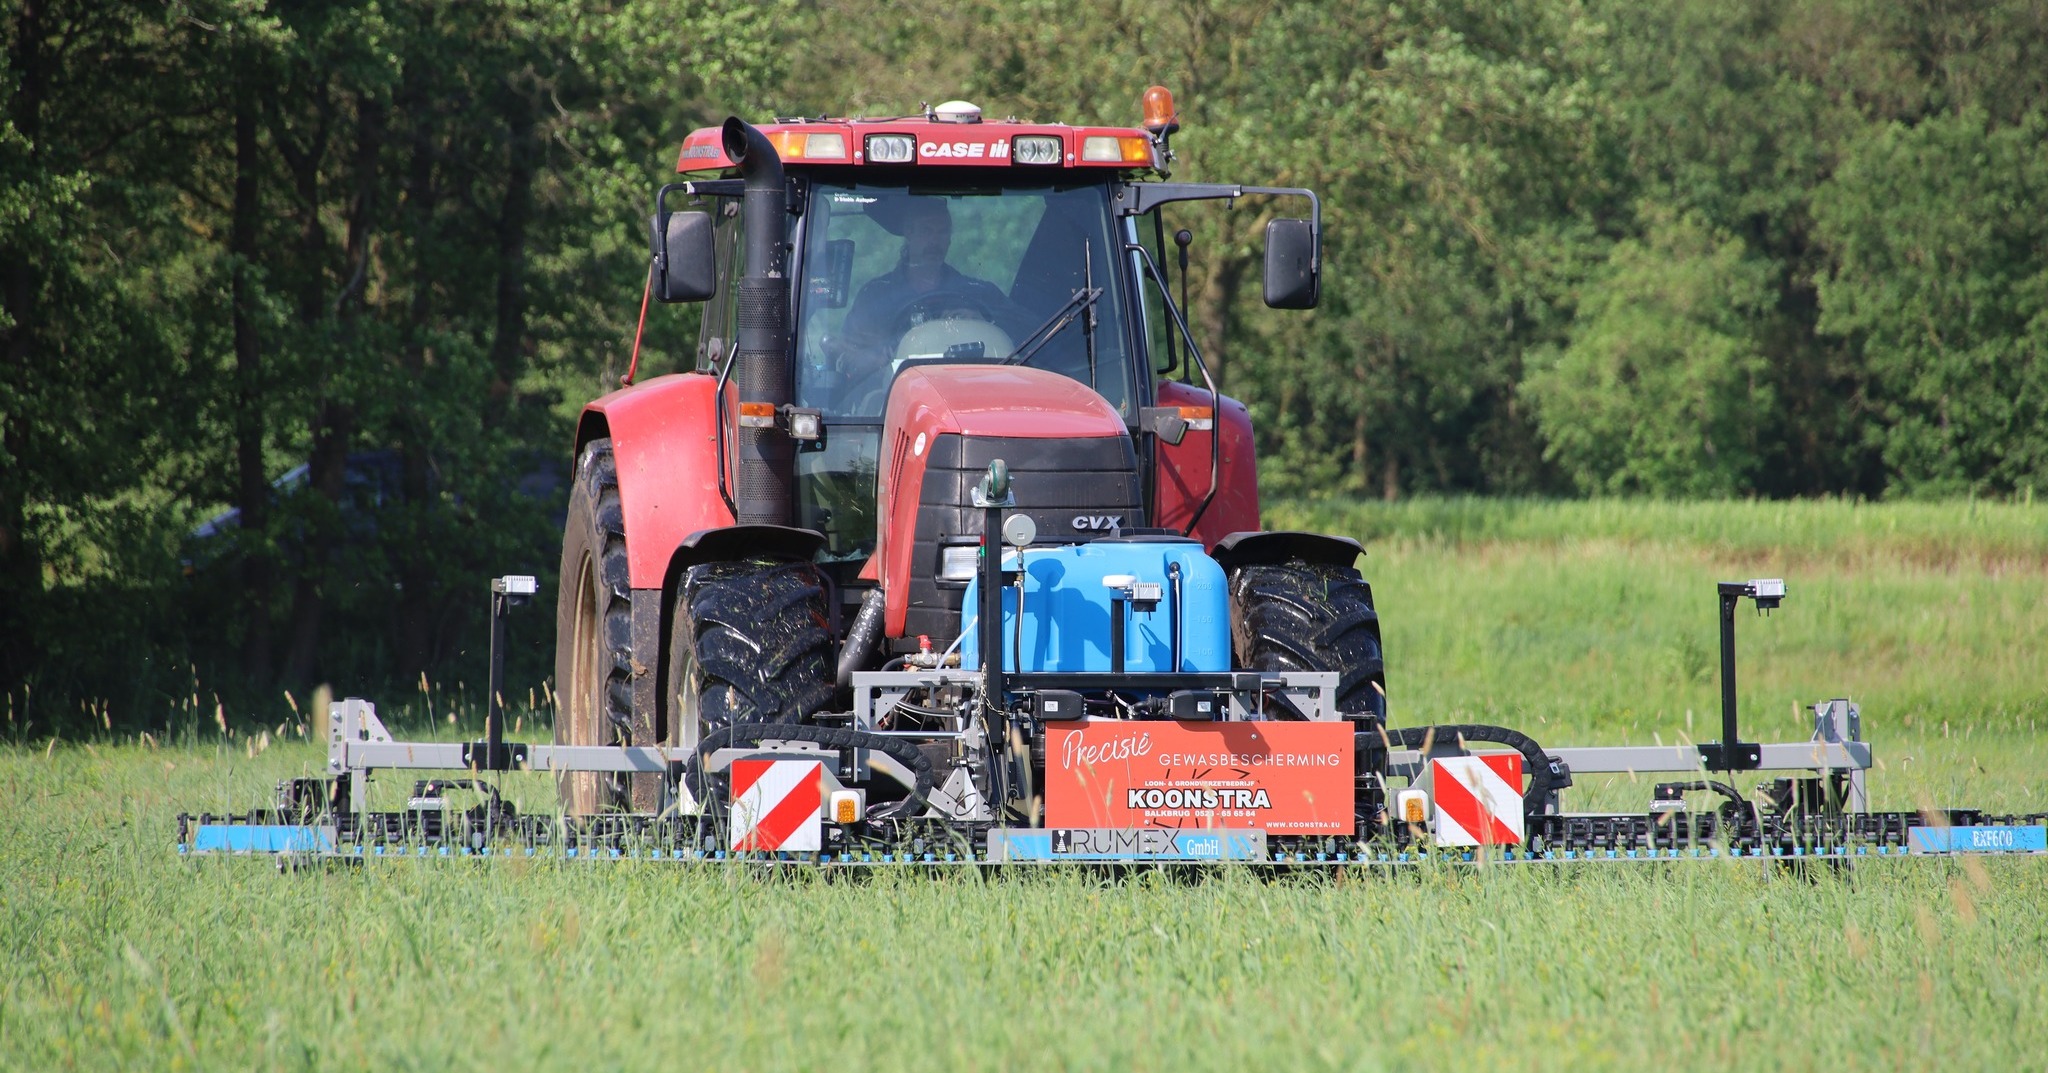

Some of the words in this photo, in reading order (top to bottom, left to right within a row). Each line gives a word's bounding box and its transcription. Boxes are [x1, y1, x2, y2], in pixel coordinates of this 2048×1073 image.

[919, 141, 985, 158] CASE
[1072, 515, 1123, 530] CVX
[1158, 752, 1341, 767] GEWASBESCHERMING
[1127, 788, 1272, 809] KOONSTRA
[1144, 810, 1191, 818] BALKBRUG
[1221, 810, 1232, 818] 65
[1233, 810, 1244, 818] 65
[1245, 810, 1256, 818] 84
[1265, 821, 1341, 829] WWW.KOONSTRA.EU
[1073, 829, 1181, 854] RUMEX
[1186, 838, 1220, 856] GmbH
[1972, 830, 2013, 847] RXF600
